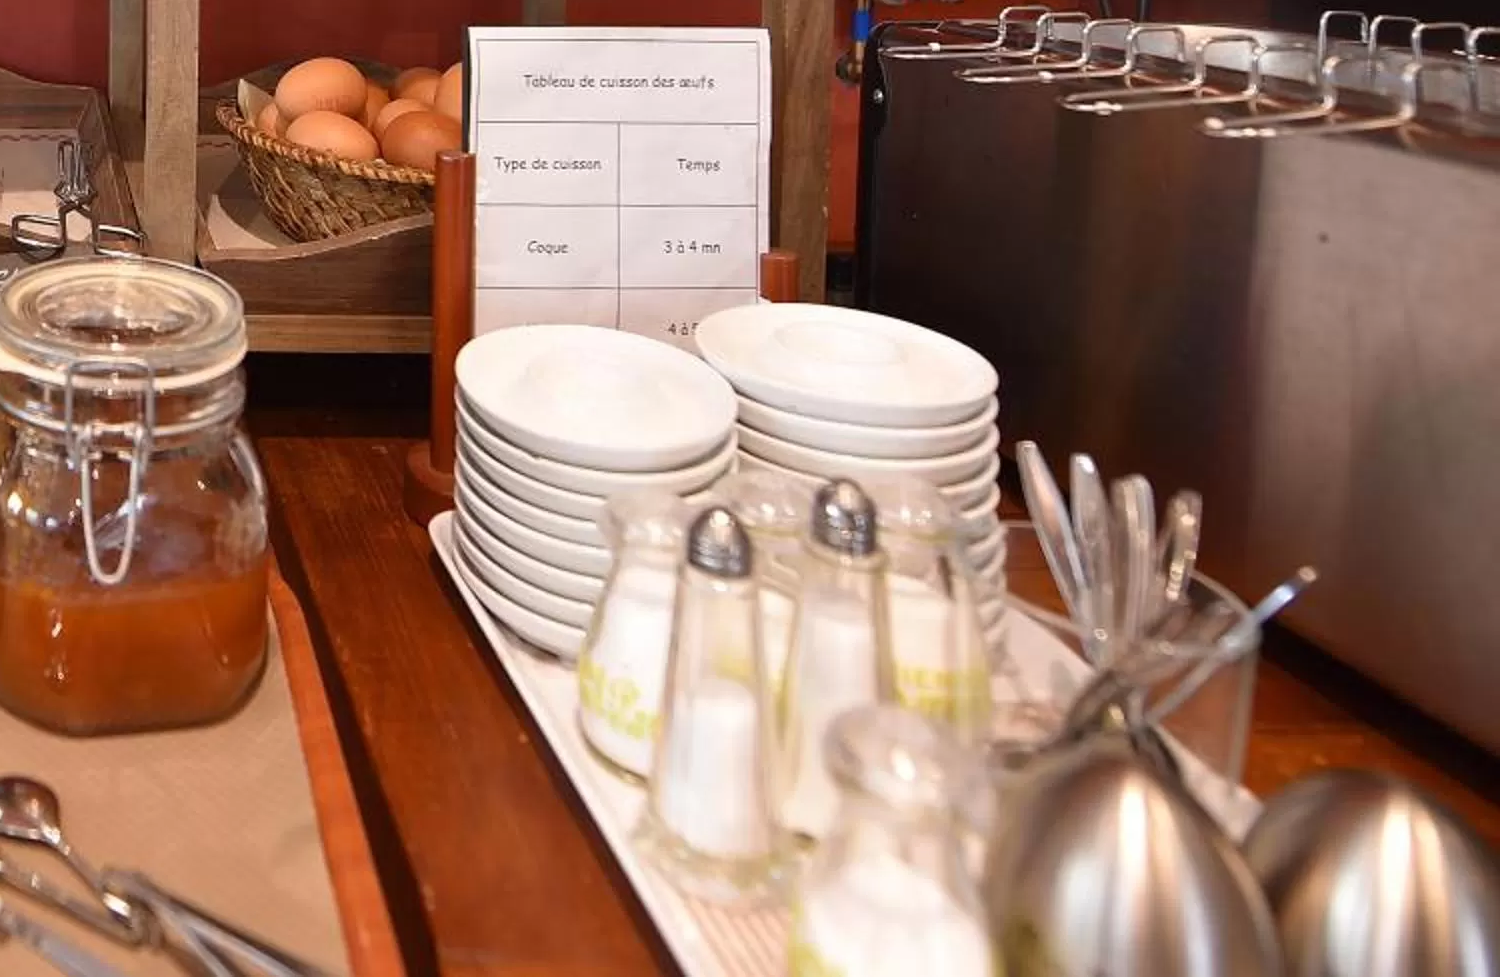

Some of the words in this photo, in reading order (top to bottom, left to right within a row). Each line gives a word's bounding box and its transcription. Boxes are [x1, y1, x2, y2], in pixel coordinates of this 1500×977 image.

[523, 74, 575, 88] Tableau
[579, 74, 595, 88] de
[599, 74, 649, 88] cuisson
[652, 75, 675, 88] des
[493, 156, 527, 174] Type
[531, 157, 549, 170] de
[552, 158, 602, 170] cuisson
[677, 158, 721, 173] Temps
[526, 240, 569, 259] Coque
[663, 240, 673, 255] 3
[676, 240, 686, 255] à
[688, 240, 698, 254] 4
[700, 242, 722, 255] mn
[667, 322, 677, 336] 4
[680, 322, 689, 336] à
